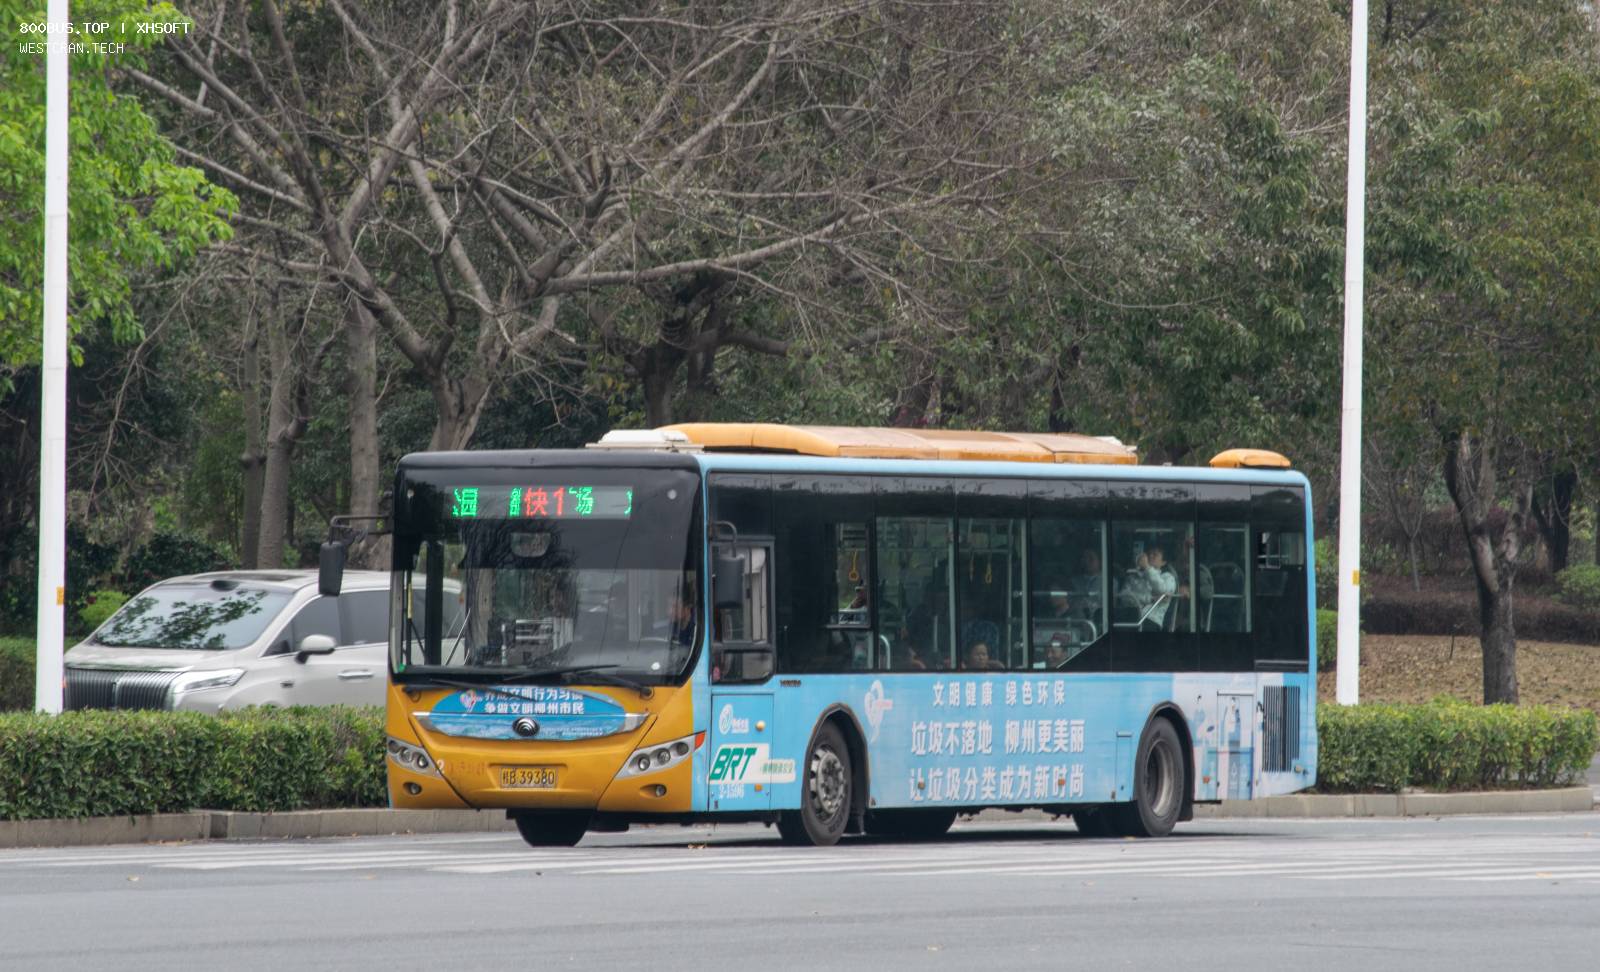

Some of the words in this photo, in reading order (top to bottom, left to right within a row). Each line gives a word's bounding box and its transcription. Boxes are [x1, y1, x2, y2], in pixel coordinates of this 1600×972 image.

[484, 702, 585, 715] 争做文明柳州市民
[933, 681, 993, 707] 文明健康
[1005, 680, 1065, 705] 绿色环保
[911, 720, 993, 756] 垃圾不落地
[1005, 719, 1086, 754] 柳州更美丽
[709, 747, 757, 780] BRT
[909, 763, 1085, 801] 让垃圾分类成为新时尚
